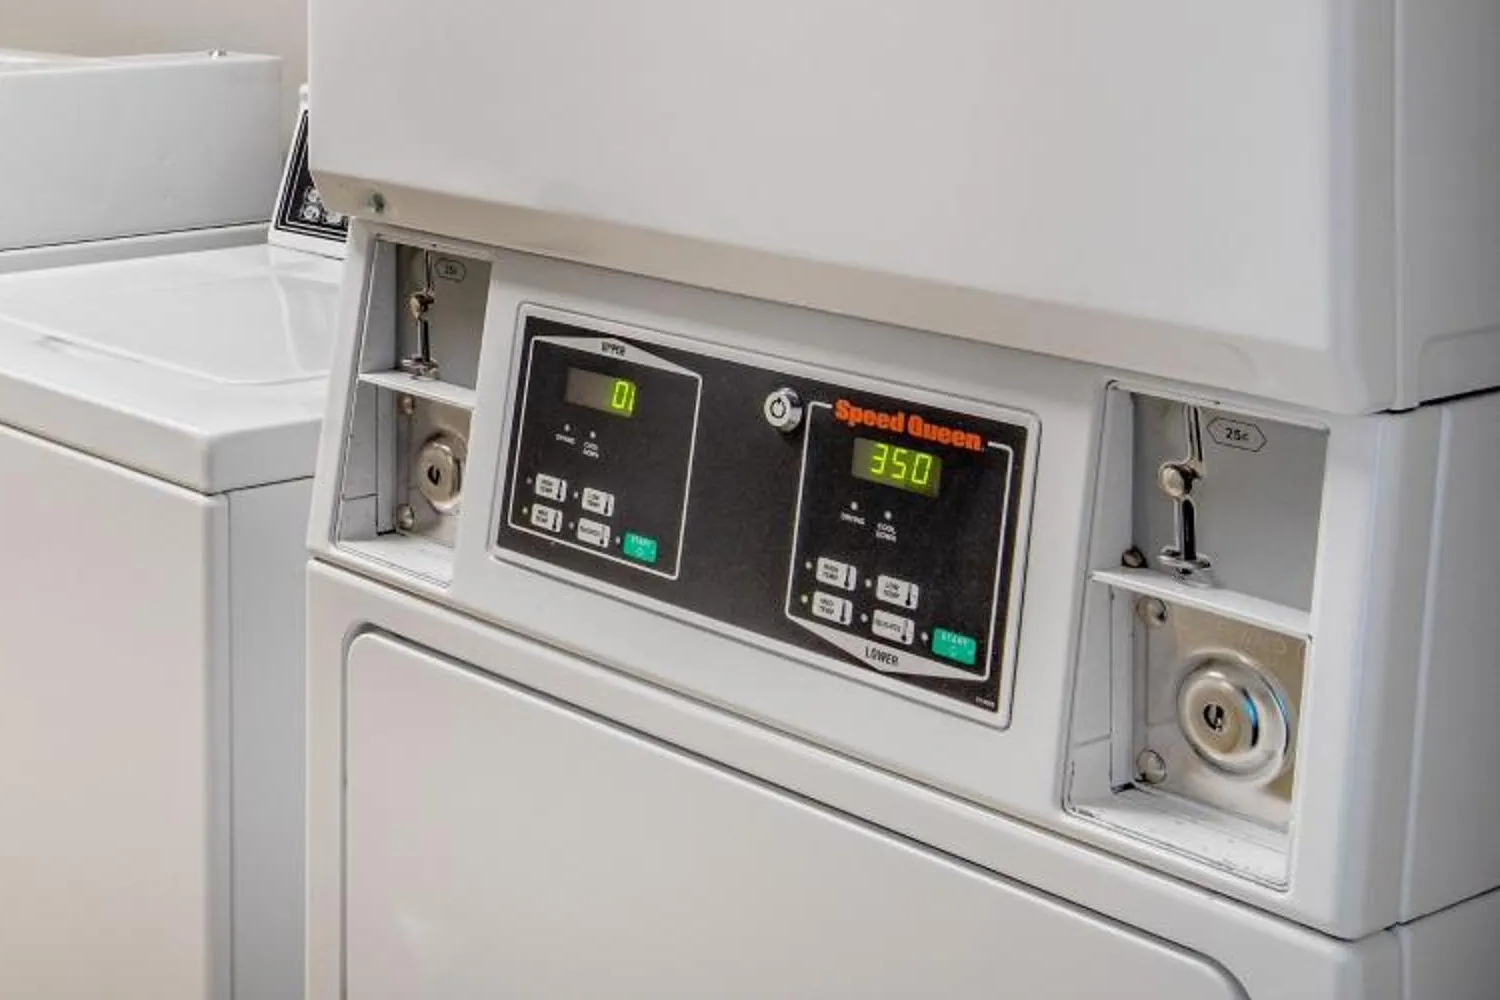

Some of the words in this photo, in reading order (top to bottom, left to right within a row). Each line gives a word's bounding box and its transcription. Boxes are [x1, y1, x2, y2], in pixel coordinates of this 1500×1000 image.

[834, 399, 905, 433] Speed
[908, 414, 982, 451] Queen
[870, 443, 933, 485] 350
[864, 646, 900, 666] LOWER
